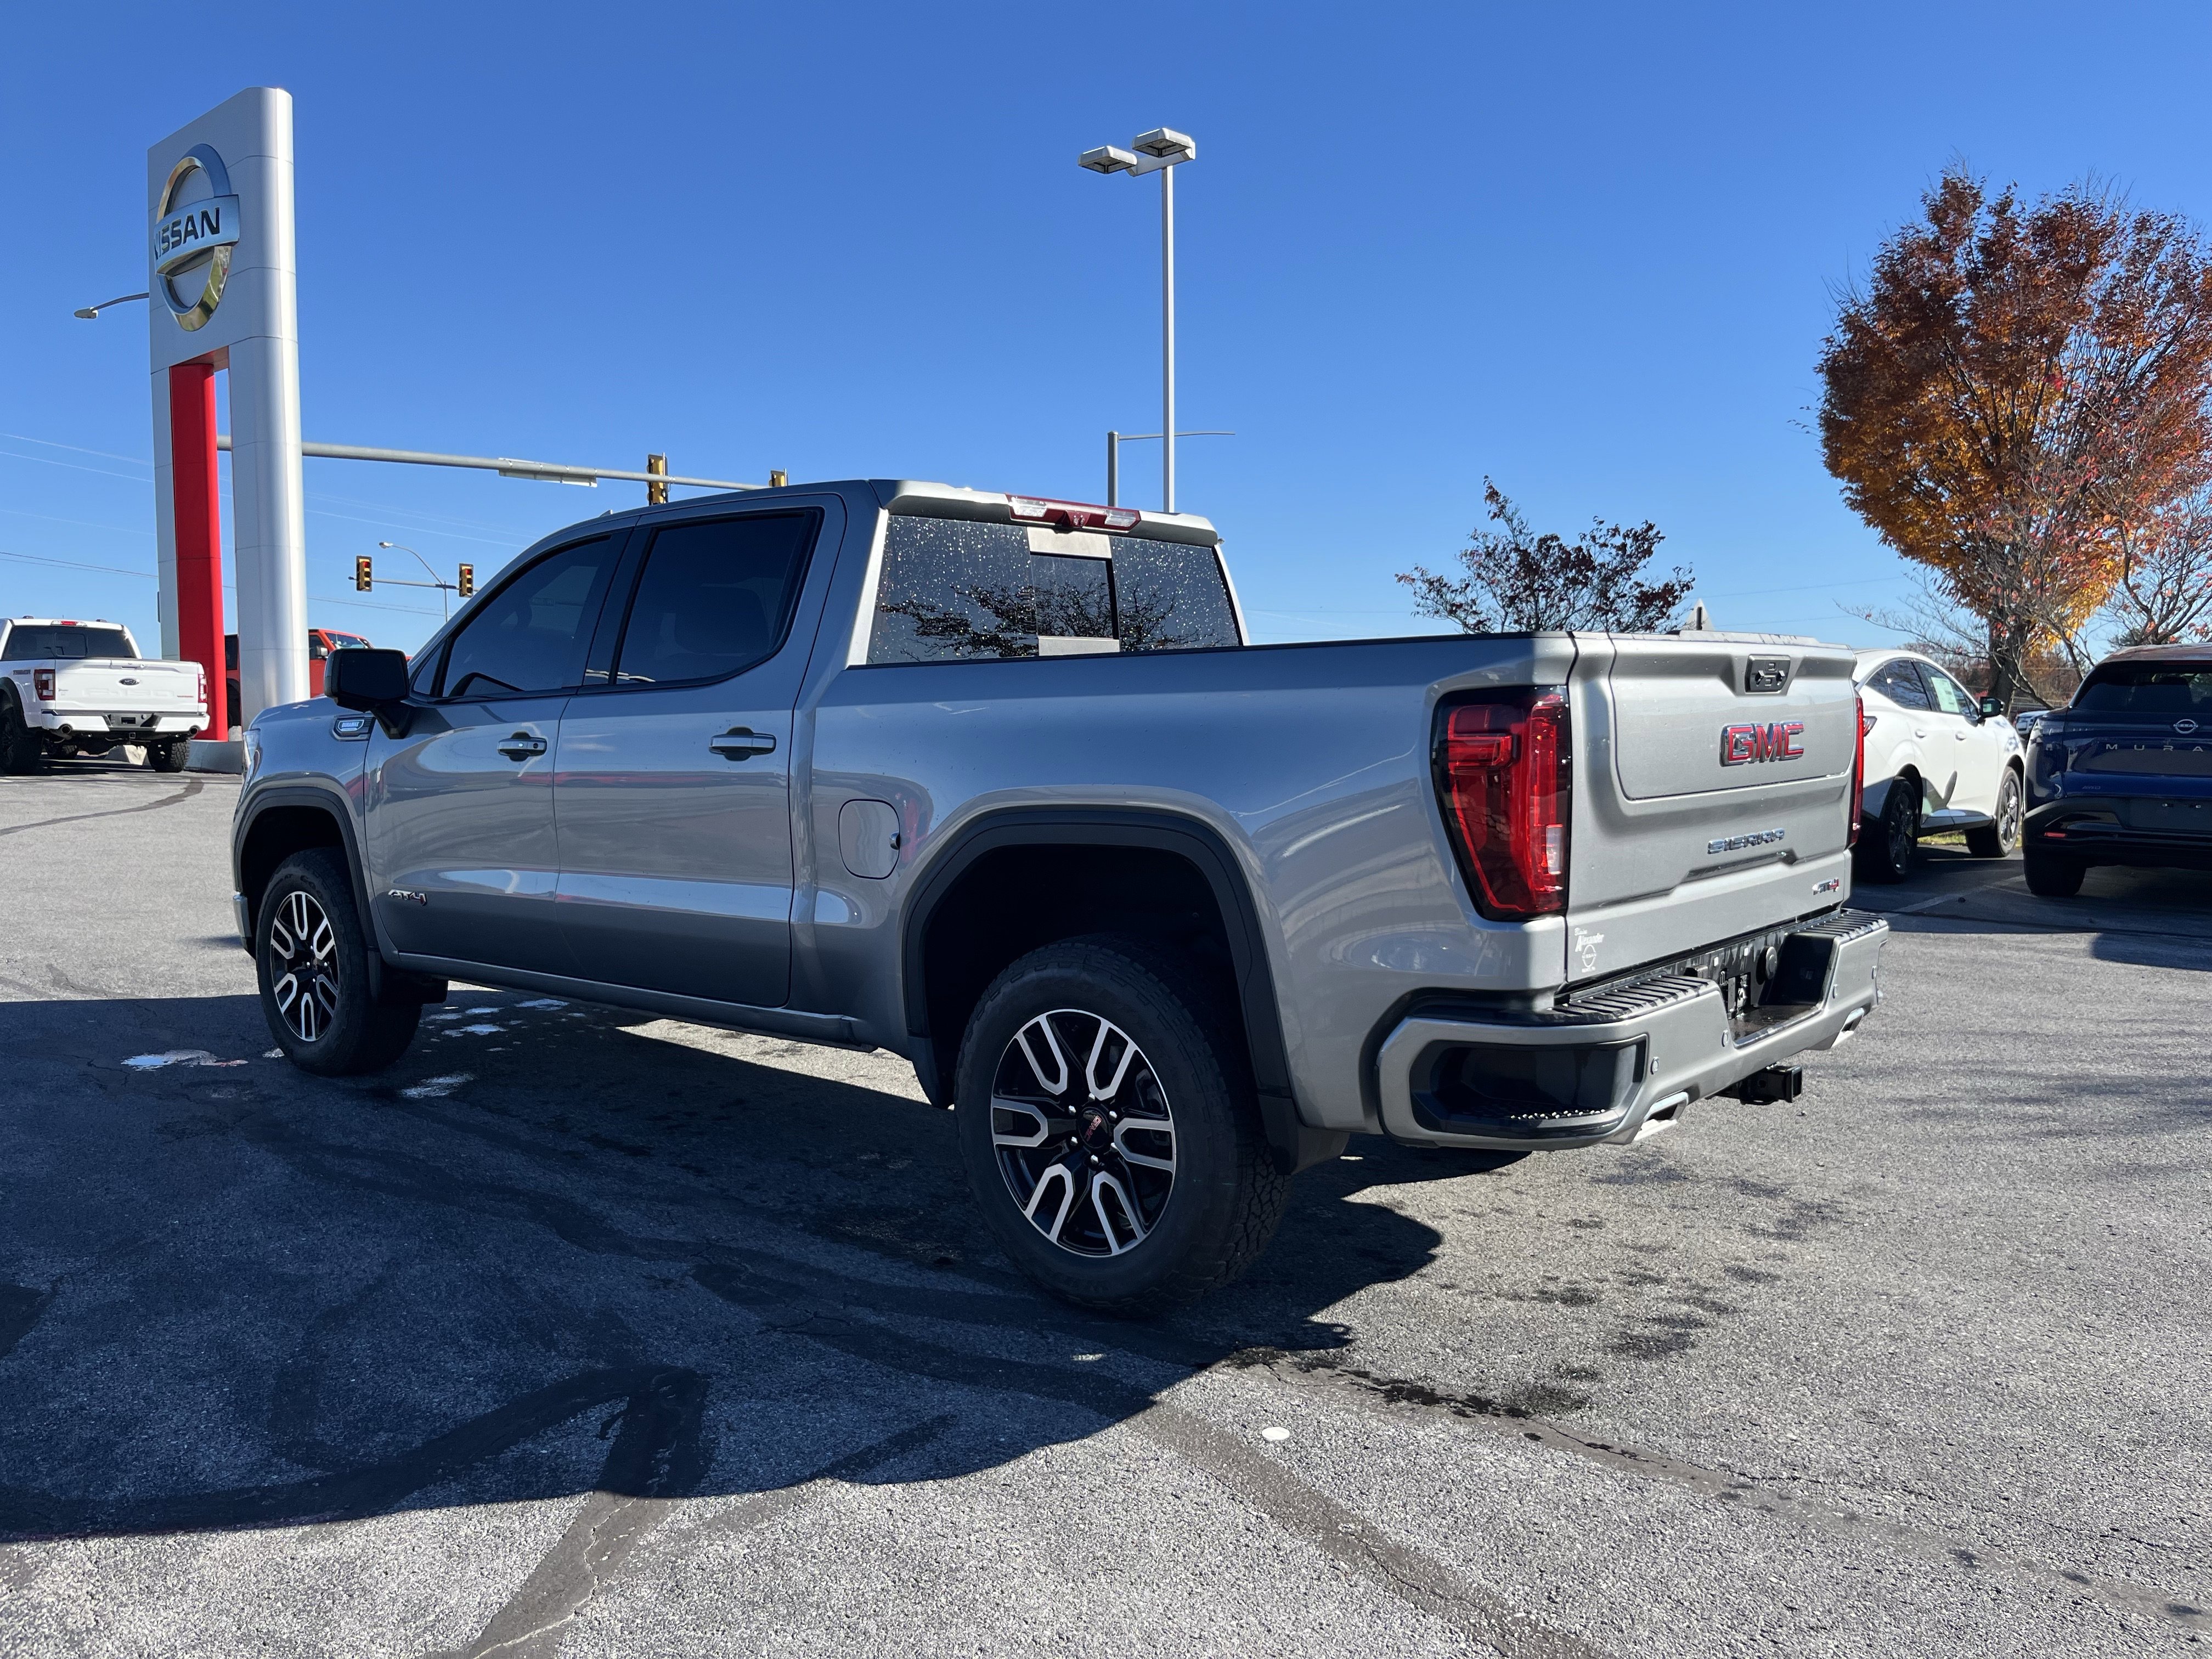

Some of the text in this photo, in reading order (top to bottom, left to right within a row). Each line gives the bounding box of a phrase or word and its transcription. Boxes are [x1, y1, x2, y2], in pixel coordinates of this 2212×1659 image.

[1719, 720, 1804, 767] GMC
[2106, 743, 2204, 752] MURA
[1707, 828, 1785, 854] SIERRA
[1812, 878, 1839, 895] AT4
[388, 889, 427, 906] AT4
